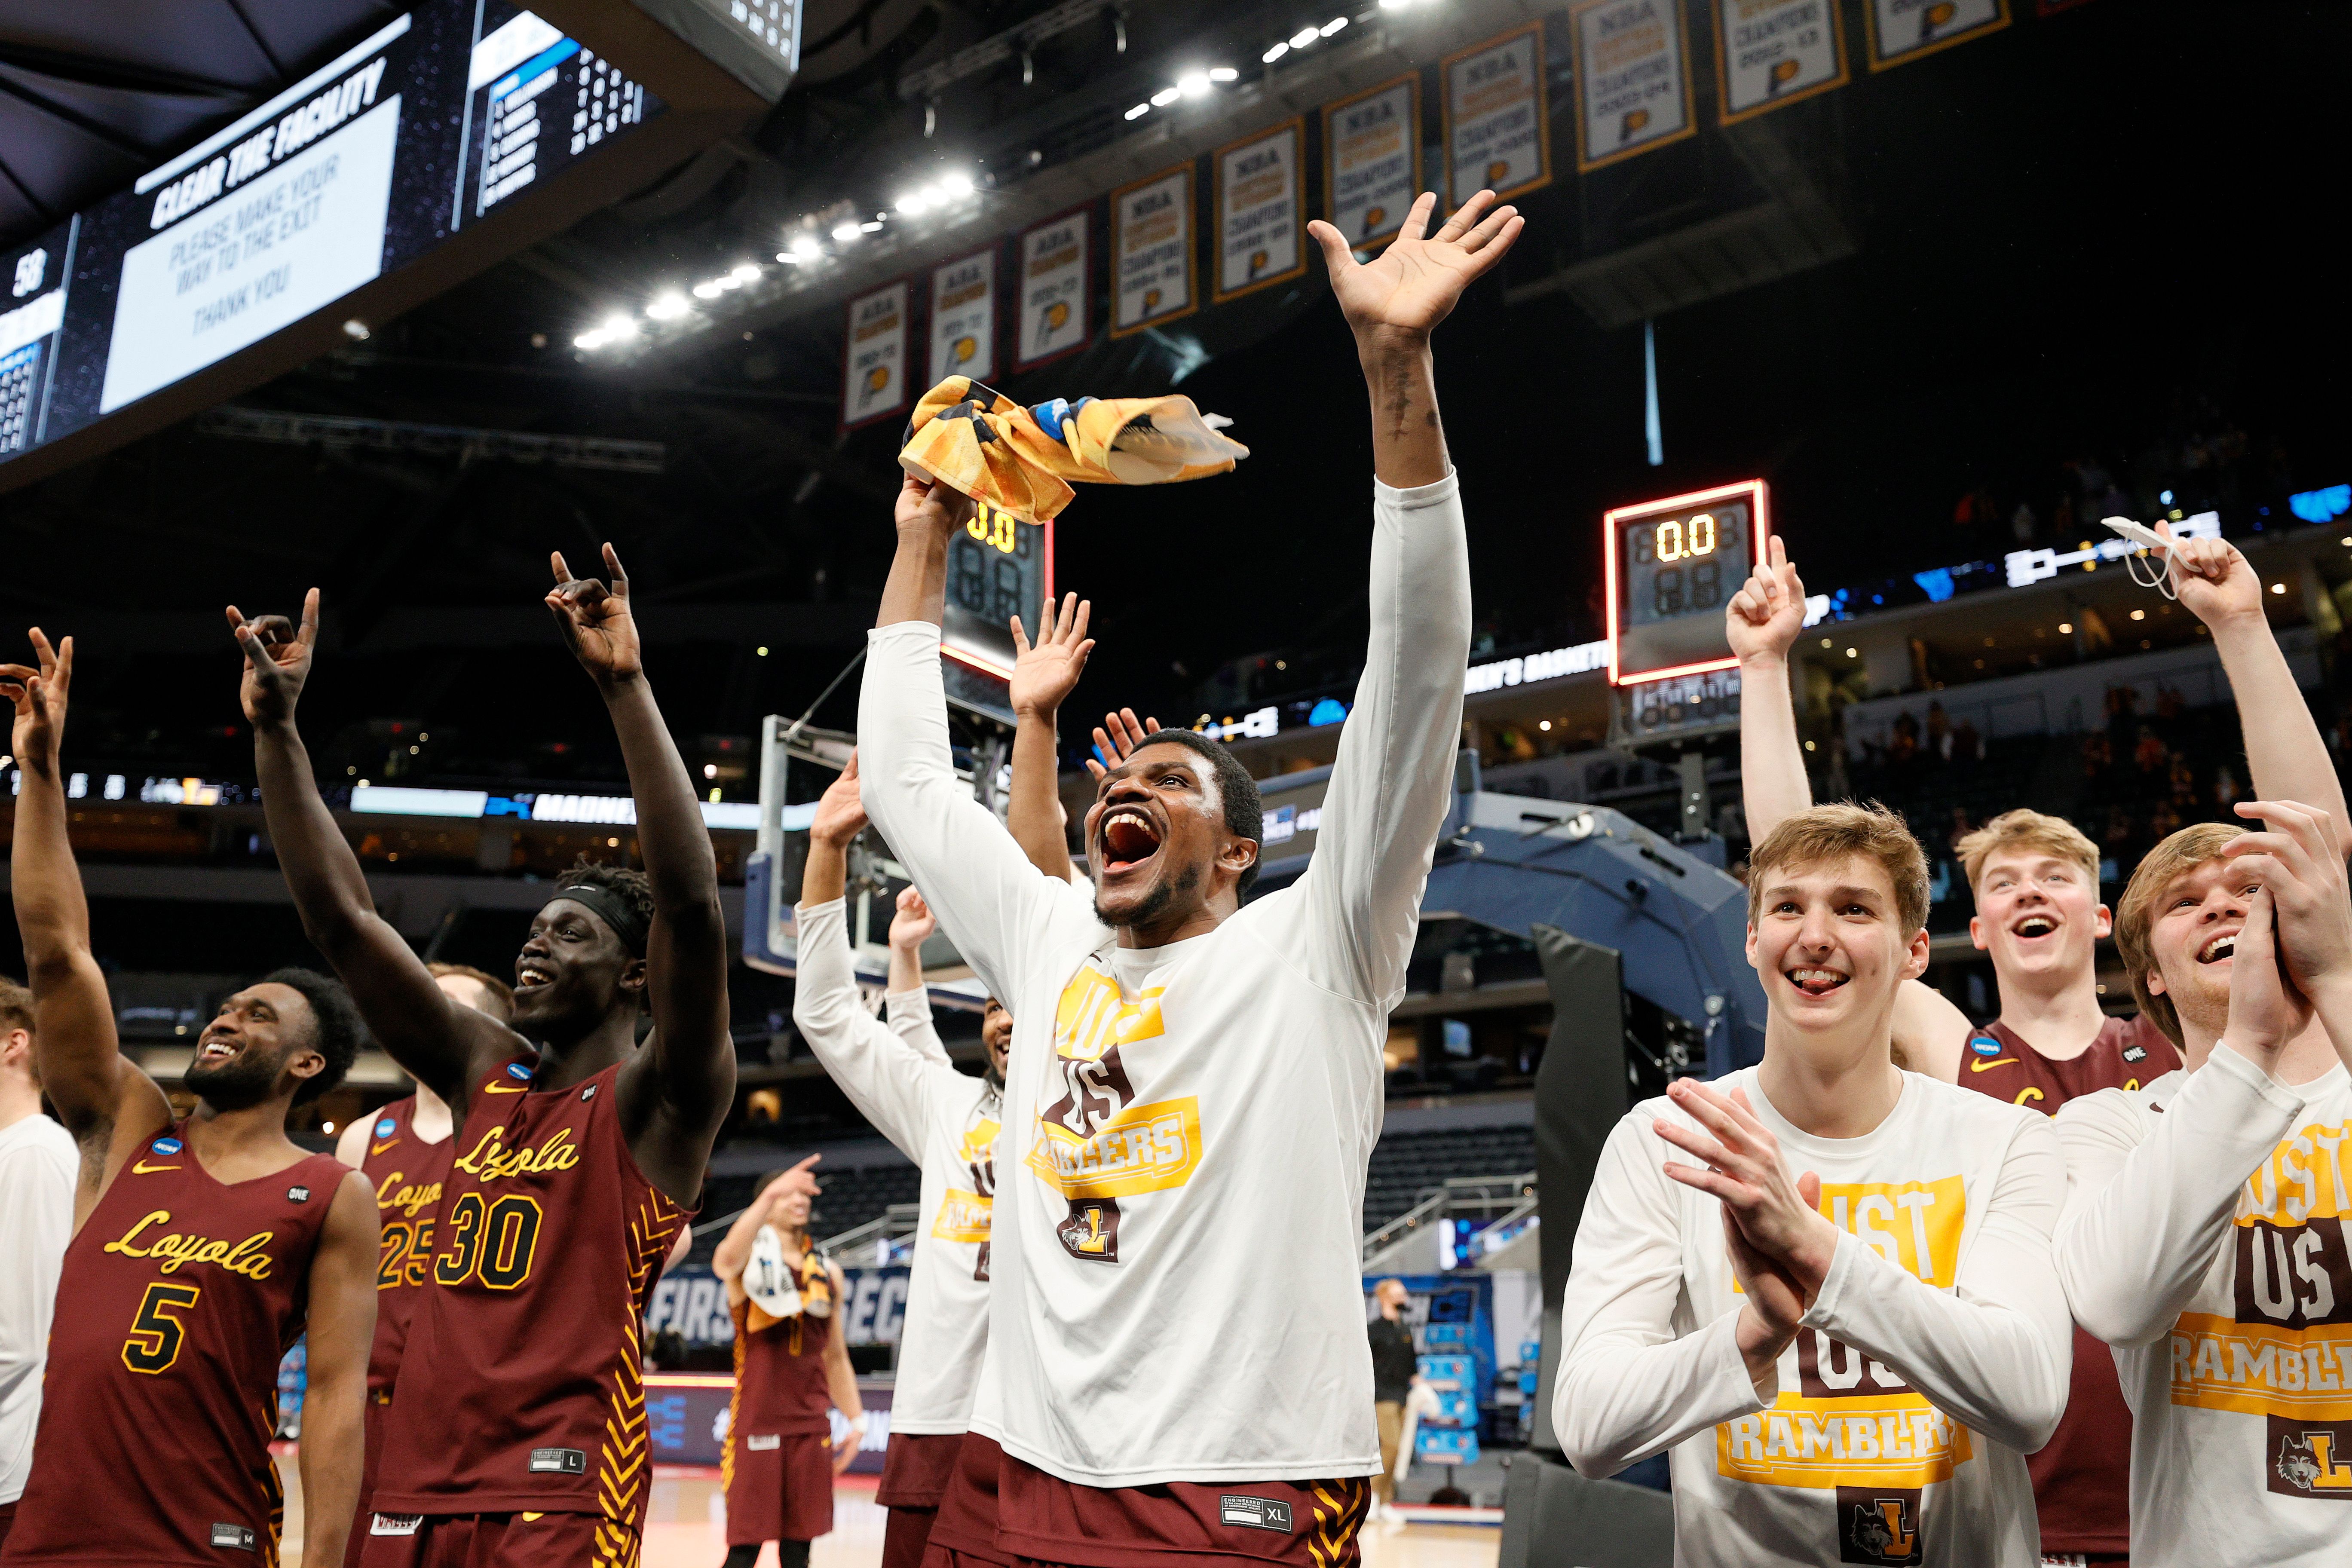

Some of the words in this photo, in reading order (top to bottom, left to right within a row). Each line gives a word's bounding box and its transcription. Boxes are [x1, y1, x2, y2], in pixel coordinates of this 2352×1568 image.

[1599, 1, 1656, 34] NBA
[150, 156, 228, 230] CLEAR
[226, 125, 277, 187] THE
[272, 56, 387, 160] FACILITY
[1236, 148, 1280, 178] NBA
[168, 217, 229, 272] PLEASE
[234, 183, 286, 235] MAKE
[291, 153, 340, 203] YOUR
[1133, 191, 1172, 218] NBA
[12, 248, 48, 297] 58
[176, 257, 212, 297] WAY
[217, 242, 238, 273] TO
[243, 220, 275, 262] THE
[279, 194, 322, 242] EXIT
[192, 283, 249, 337] THANK
[254, 262, 291, 304] YOU
[1656, 514, 1715, 562] 0.0
[2125, 1046, 2146, 1061] ONE
[1059, 1059, 1121, 1135] US
[455, 1126, 580, 1182] Loyola
[288, 1188, 309, 1201] ONE
[103, 1210, 274, 1281] Loyola
[376, 1218, 436, 1290] 25
[434, 1192, 543, 1289] 30
[2253, 1226, 2334, 1322] US
[121, 1282, 200, 1375] 5
[569, 1455, 576, 1467] L
[244, 1534, 253, 1544] M
[1267, 1507, 1286, 1522] XL
